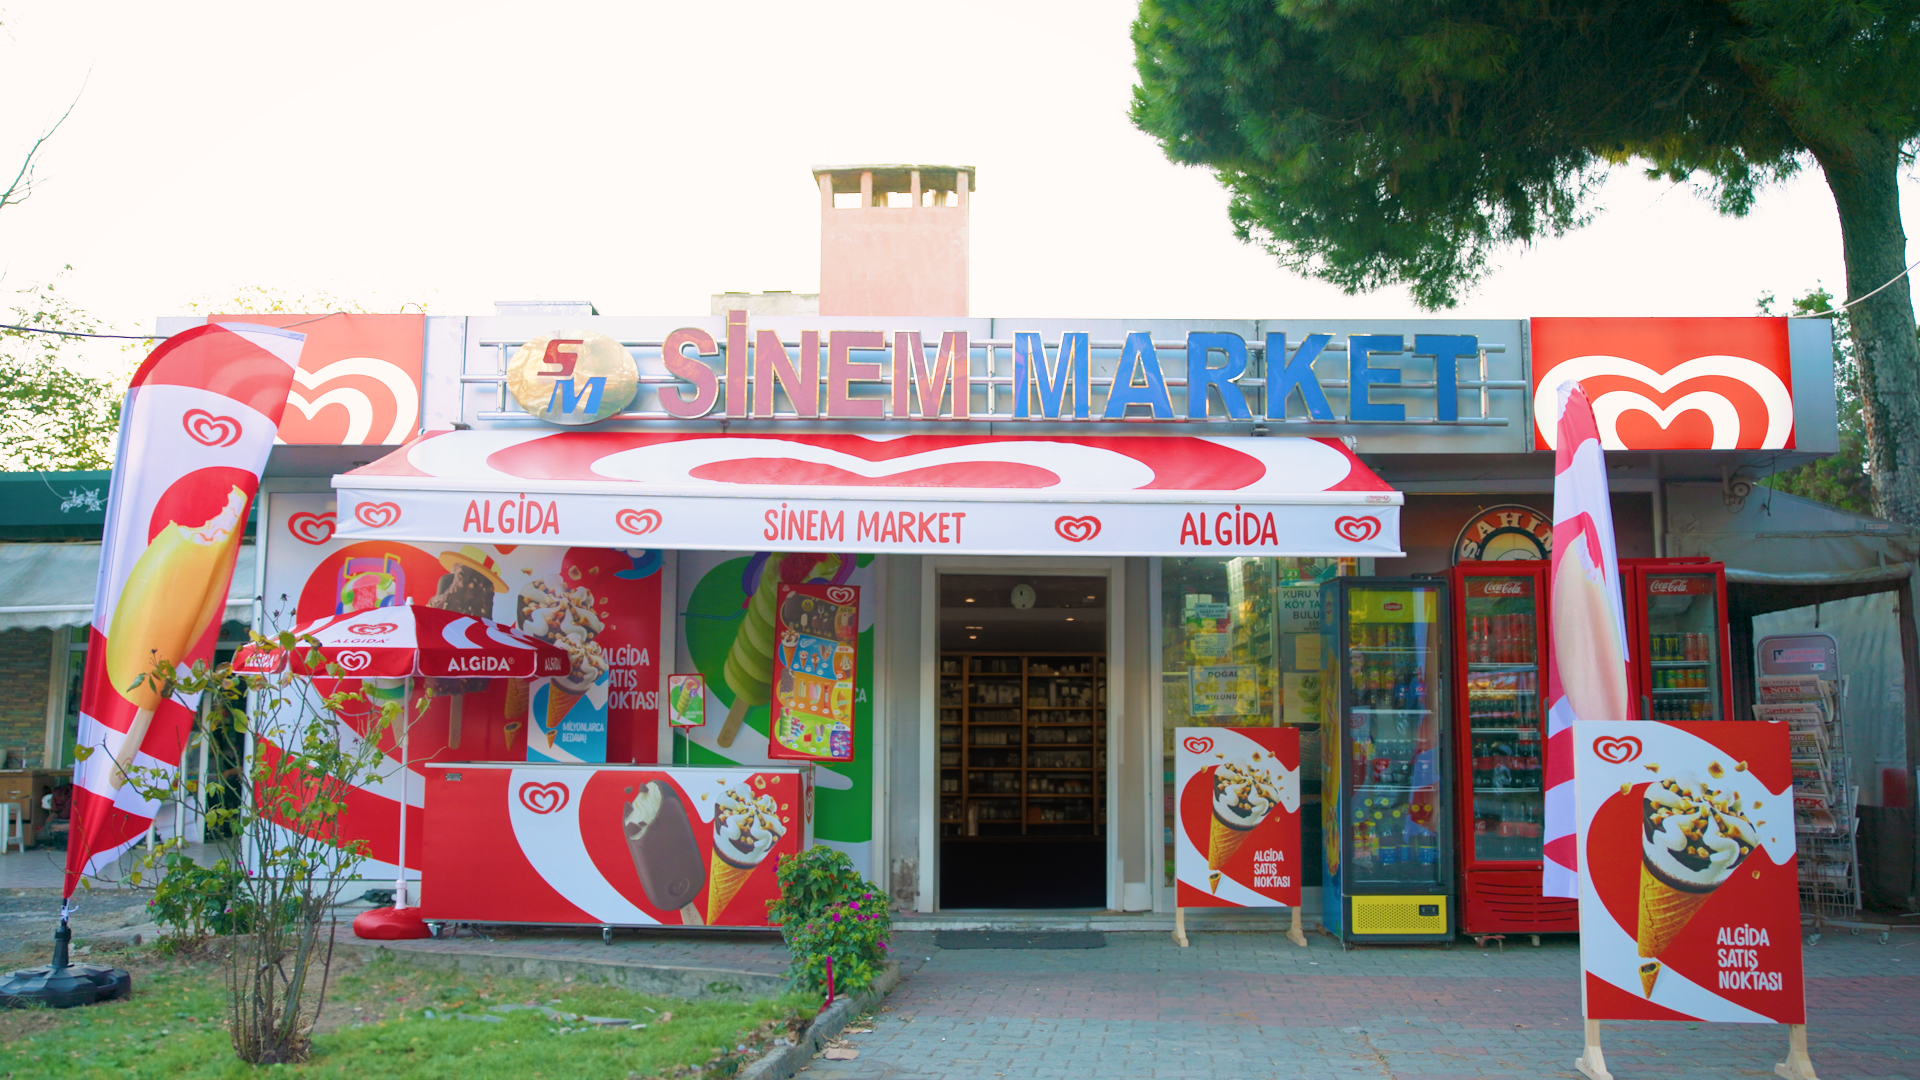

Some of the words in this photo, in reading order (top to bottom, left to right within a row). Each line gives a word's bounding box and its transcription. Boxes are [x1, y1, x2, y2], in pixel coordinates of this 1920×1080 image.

[537, 338, 584, 377] S
[658, 310, 970, 420] SİNEM
[1012, 329, 1479, 423] MARKET
[545, 376, 607, 415] M
[463, 492, 560, 535] ALGİDA
[763, 503, 845, 543] SİNEM
[857, 511, 966, 545] MARKET
[1180, 504, 1278, 547] ALGİDA
[1283, 590, 1311, 599] KURU
[1314, 590, 1320, 598] Y
[1484, 581, 1522, 594] Coca-Cola
[1650, 579, 1688, 593] Coca-Cola
[1284, 599, 1306, 609] KÖY
[1309, 600, 1320, 608] TA
[1293, 611, 1320, 619] BULU
[601, 643, 650, 666] ALGİDA
[608, 669, 637, 691] ATIŞ
[608, 691, 659, 710] OKTASI
[563, 720, 604, 732] MİLYONLARCA
[1254, 848, 1284, 862] ALGİDA
[1254, 863, 1277, 876] SATIŞ
[1254, 876, 1290, 887] NOKTASI
[1717, 924, 1770, 946] ALGİDA
[1718, 948, 1758, 971] SATIŞ
[1719, 971, 1782, 991] NOKTASI
